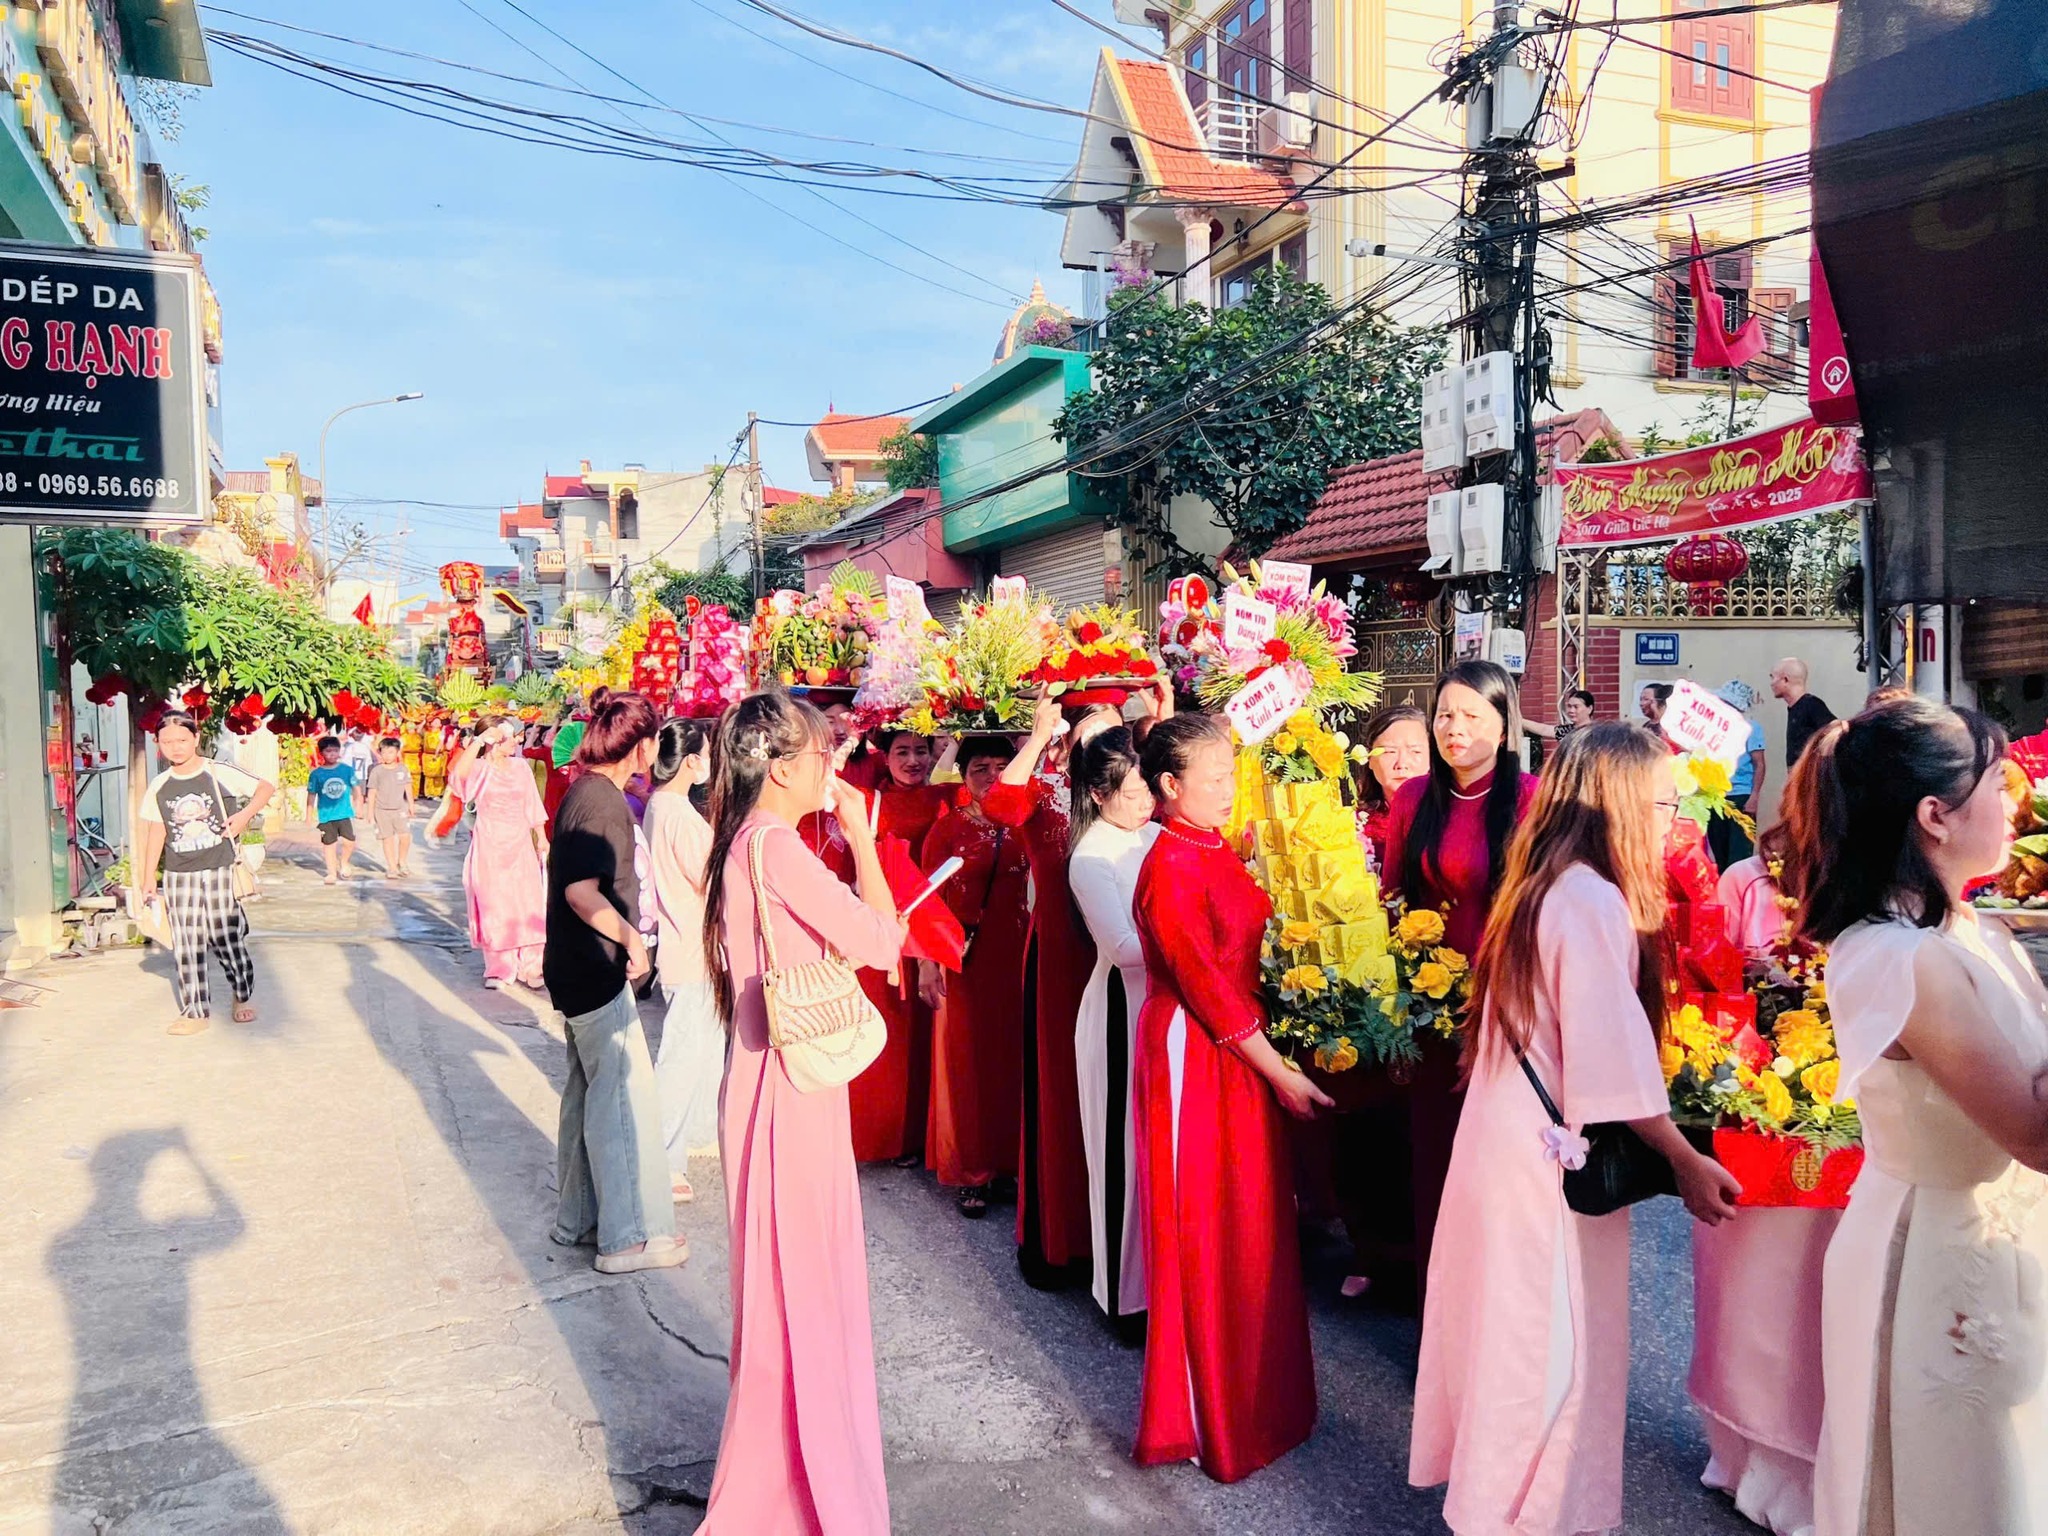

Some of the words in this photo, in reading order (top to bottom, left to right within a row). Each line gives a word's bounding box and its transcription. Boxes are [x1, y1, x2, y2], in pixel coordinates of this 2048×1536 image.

[3, 275, 78, 305] DÉP
[93, 285, 144, 311] DA
[45, 320, 173, 389] HẠNH
[45, 393, 102, 416] Hiệu
[38, 473, 180, 499] 0969.56.6688
[1768, 487, 1802, 506] 2025
